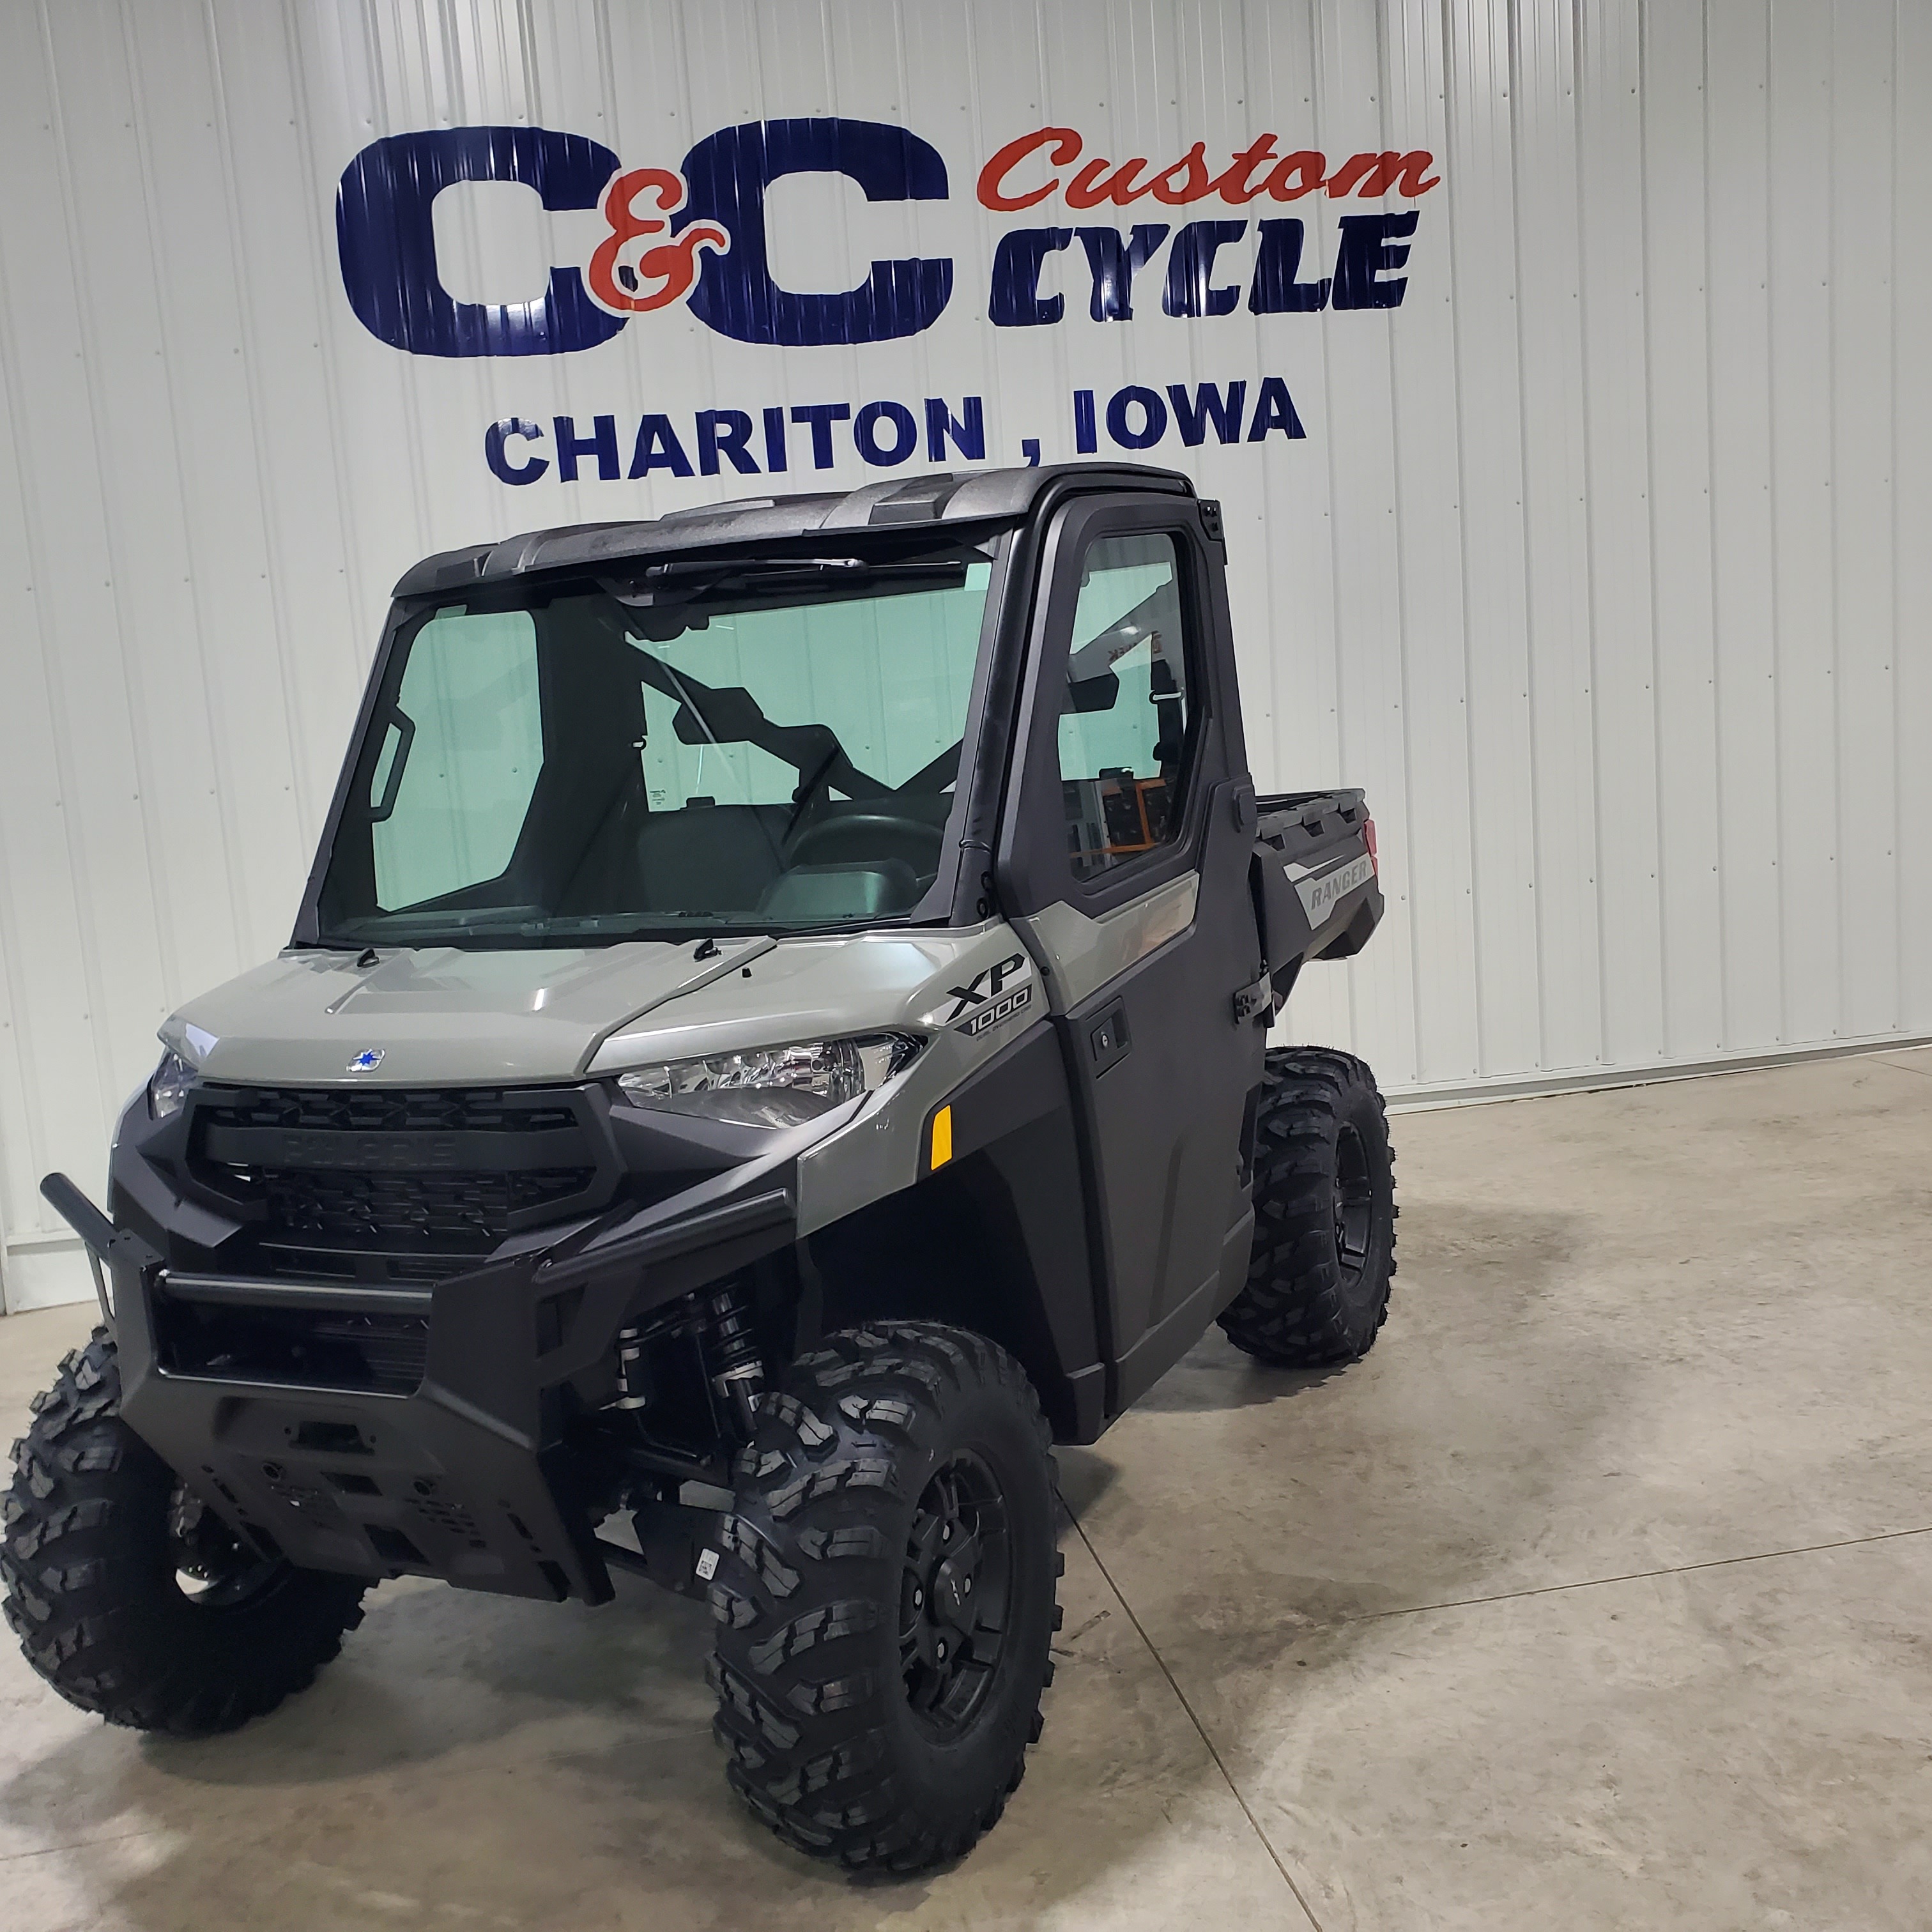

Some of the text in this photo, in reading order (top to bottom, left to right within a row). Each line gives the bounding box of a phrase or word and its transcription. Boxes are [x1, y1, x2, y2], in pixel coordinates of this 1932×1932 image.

[976, 127, 1441, 212] Custom
[336, 117, 953, 358] C&C
[988, 210, 1420, 327] CYCLE
[485, 395, 986, 486] CHARITON
[1073, 377, 1307, 454] IOWA
[1310, 860, 1368, 910] RANGER
[946, 953, 1025, 1023] XP
[970, 988, 1029, 1034] 1000
